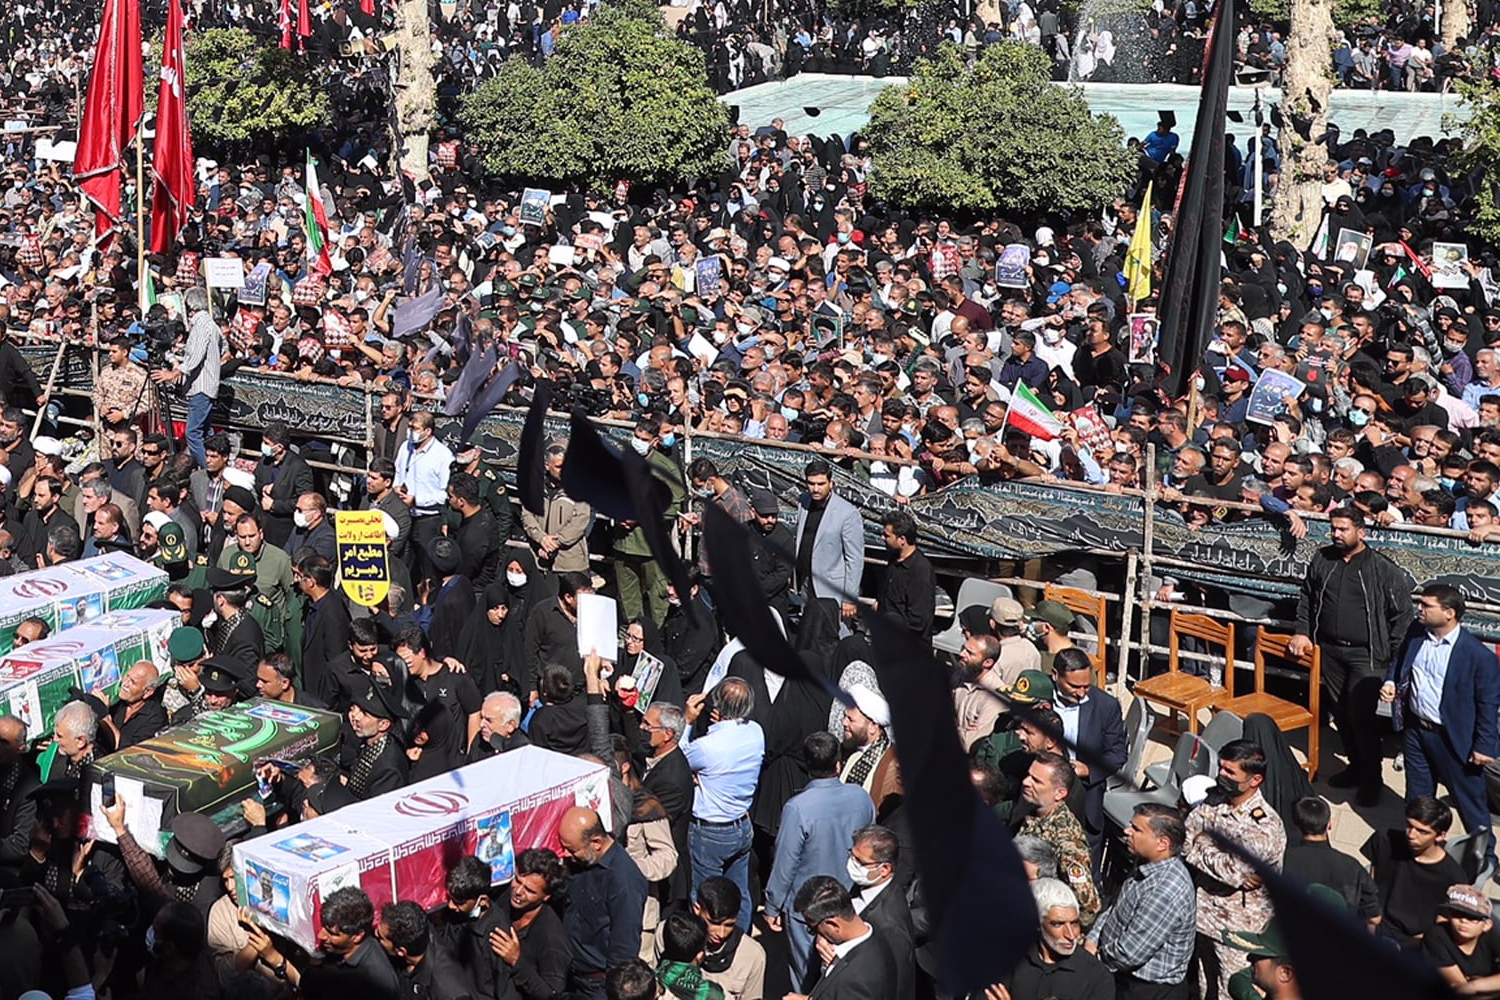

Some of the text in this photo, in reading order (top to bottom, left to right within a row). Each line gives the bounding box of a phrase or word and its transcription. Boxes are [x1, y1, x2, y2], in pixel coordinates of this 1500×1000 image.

[339, 530, 356, 541] ولایت
[363, 530, 384, 540] اطاعت
[342, 545, 383, 561] مطیع امر
[344, 565, 384, 578] رهبریم
